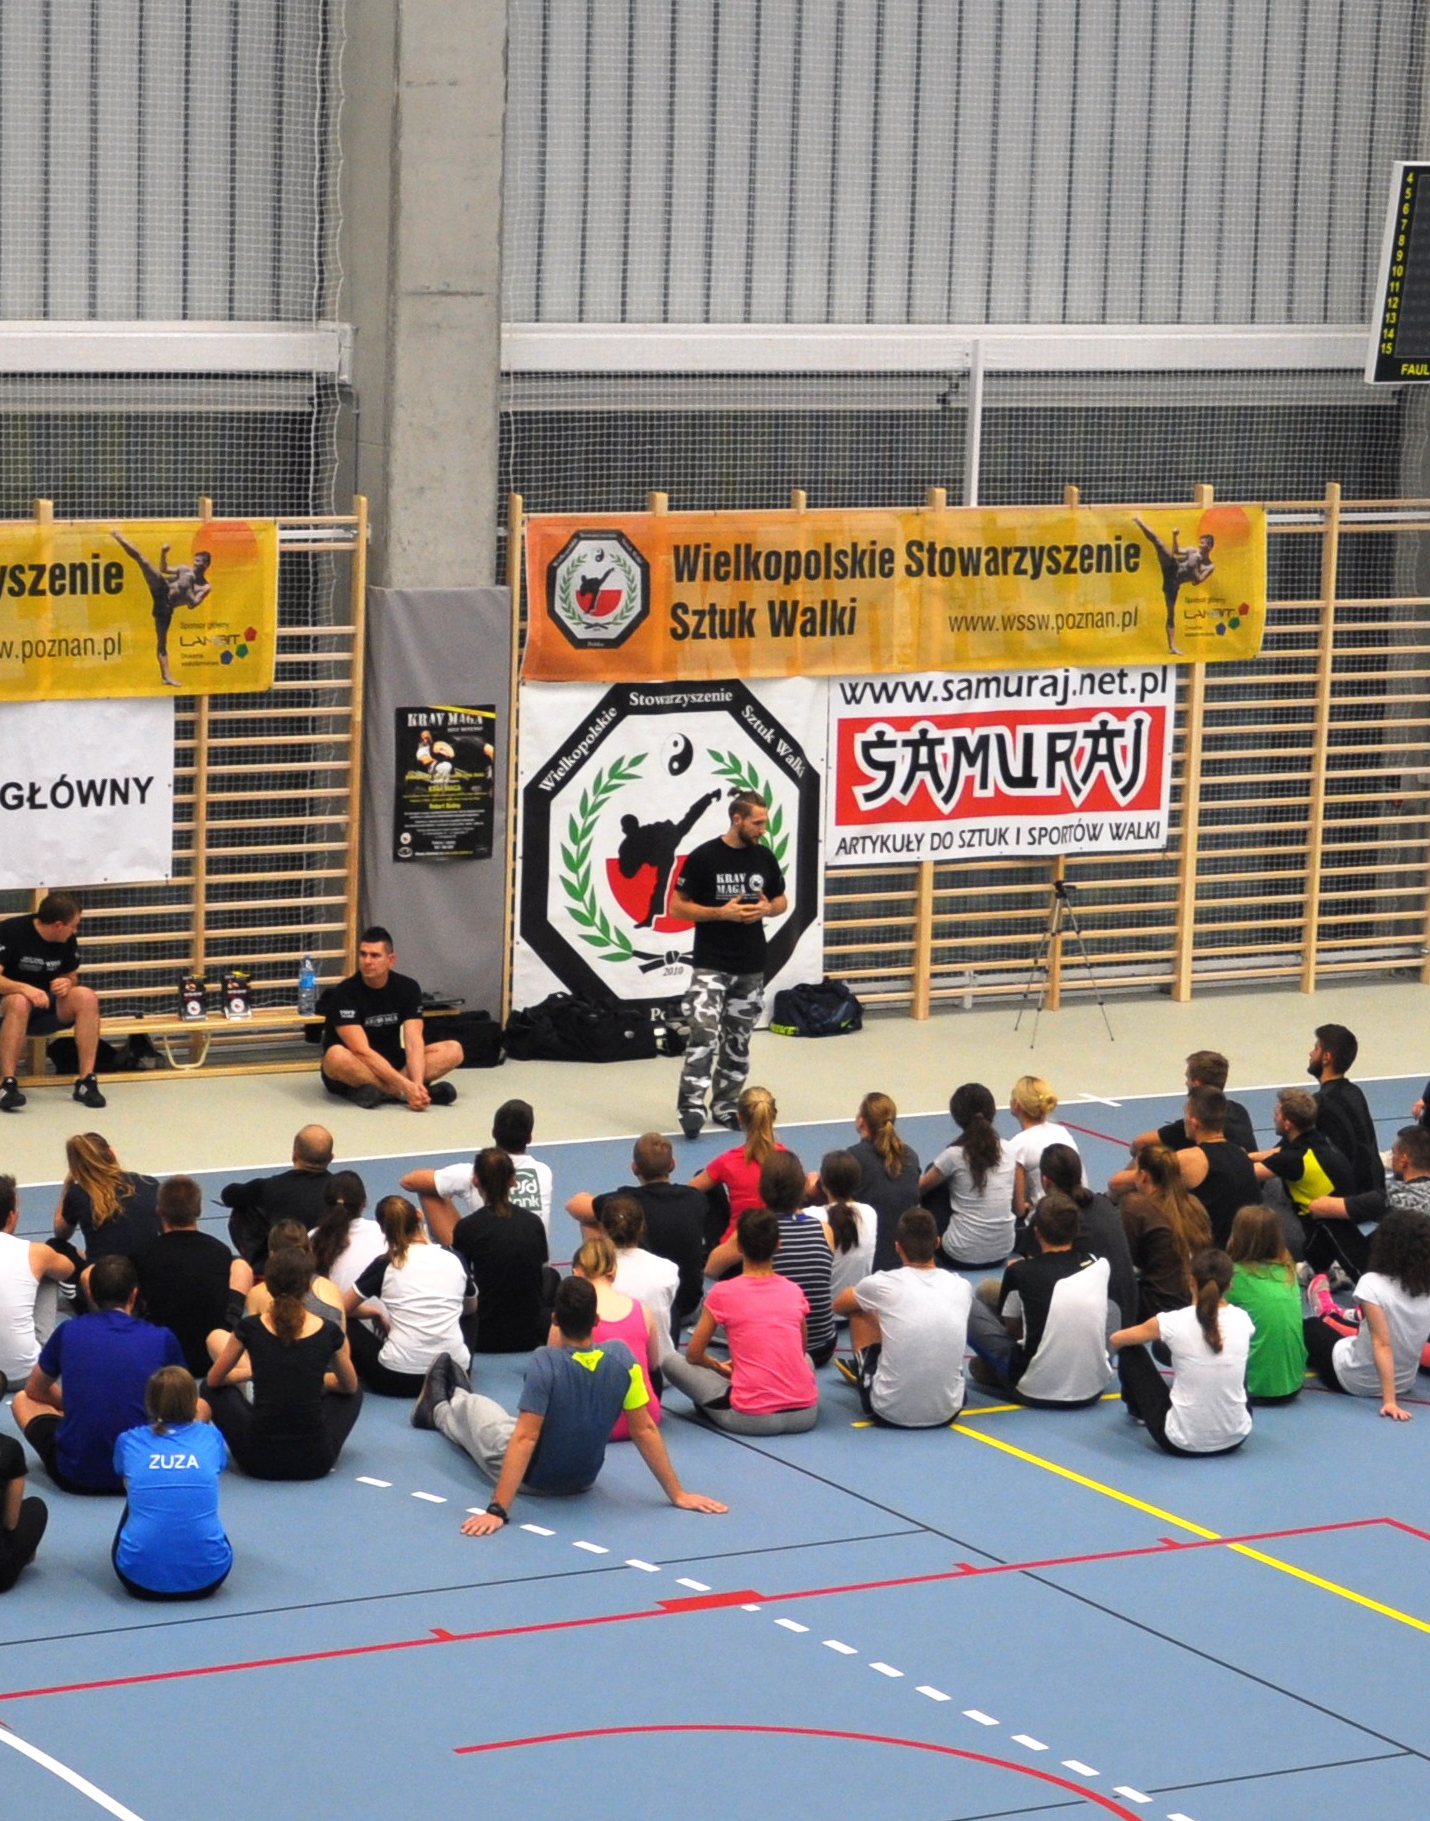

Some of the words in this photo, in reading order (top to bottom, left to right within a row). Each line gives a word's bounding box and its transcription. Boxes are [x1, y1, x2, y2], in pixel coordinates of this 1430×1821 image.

[1406, 172, 1414, 183] 4
[1404, 187, 1412, 199] 5
[1402, 202, 1410, 215] 6
[1401, 218, 1408, 231] 7
[1398, 234, 1406, 246] 8
[1396, 249, 1404, 261] 9
[1392, 265, 1404, 277] 10
[1389, 281, 1400, 292] 11
[1387, 297, 1400, 308] 12
[1385, 312, 1397, 323] 13
[1383, 328, 1395, 339] 14
[1381, 343, 1393, 354] 15
[1400, 363, 1430, 375] FAUL
[673, 540, 895, 585] Wielkopolskie
[904, 536, 1141, 580] Stowarzyszenie
[670, 601, 756, 641] Sztuk
[768, 597, 857, 637] Walki
[948, 606, 1138, 635] www.wssw.poznan.pl
[839, 665, 1167, 706] www.samuraj.net.pl
[407, 713, 445, 727] KRAV
[538, 706, 618, 793] Wielkopolskie
[629, 688, 733, 708] Stowarzyszenie
[741, 704, 775, 744] Sztuk
[775, 739, 807, 779] Walki
[859, 717, 1146, 807] SAMURAJ
[0, 774, 155, 810] GŁÓWNY
[835, 832, 925, 857] ARTYKUŁY
[930, 831, 954, 850] DO
[958, 826, 1010, 848] SZTUK
[1016, 826, 1021, 845] I
[1027, 819, 1104, 845] SPORTÓW
[1110, 821, 1161, 842] WALKI
[716, 873, 747, 884] KRAV
[508, 1194, 540, 1208] ank
[148, 1454, 199, 1470] ZUZA
